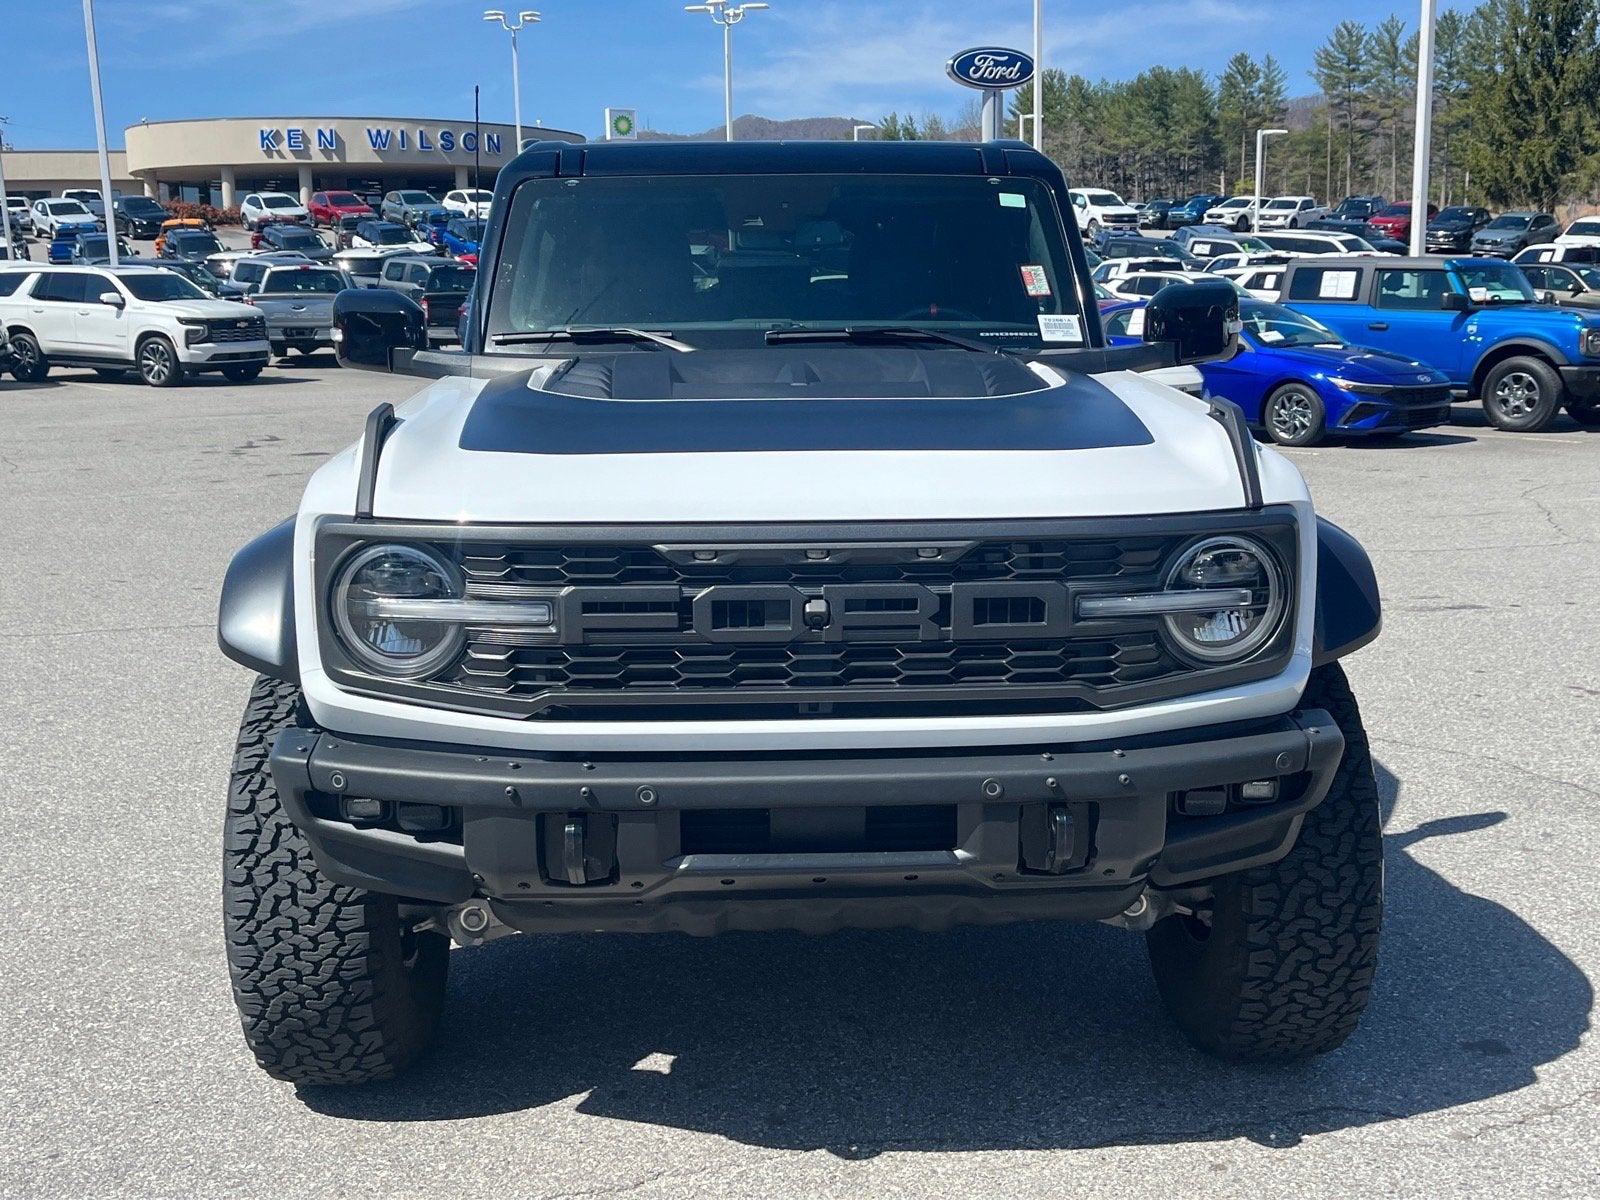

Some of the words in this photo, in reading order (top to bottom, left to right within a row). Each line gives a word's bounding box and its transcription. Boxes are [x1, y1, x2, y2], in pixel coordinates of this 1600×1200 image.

[968, 54, 1022, 79] Ford
[259, 128, 337, 150] KEN
[366, 128, 503, 154] WILSON
[560, 582, 1070, 645] FORD
